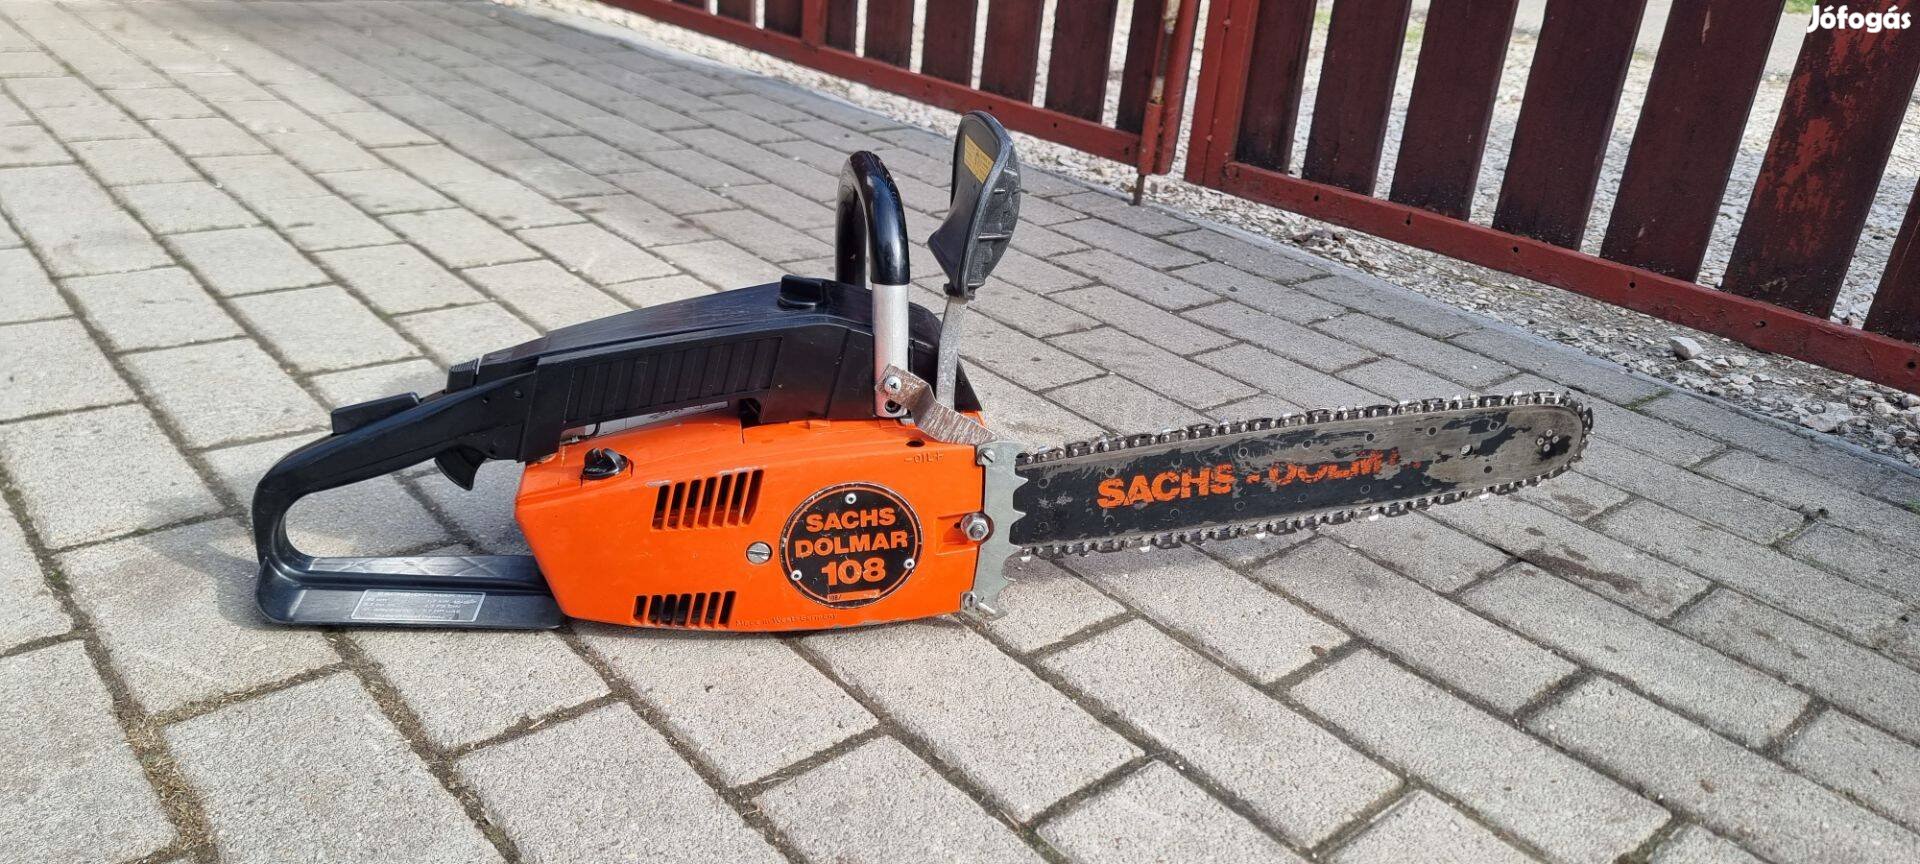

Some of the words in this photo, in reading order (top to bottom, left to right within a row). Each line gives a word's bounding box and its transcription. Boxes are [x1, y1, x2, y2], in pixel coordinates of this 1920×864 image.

[1097, 464, 1235, 508] SACHS
[806, 507, 896, 532] SACHS
[795, 530, 908, 558] DOLMAR
[822, 557, 886, 586] 108
